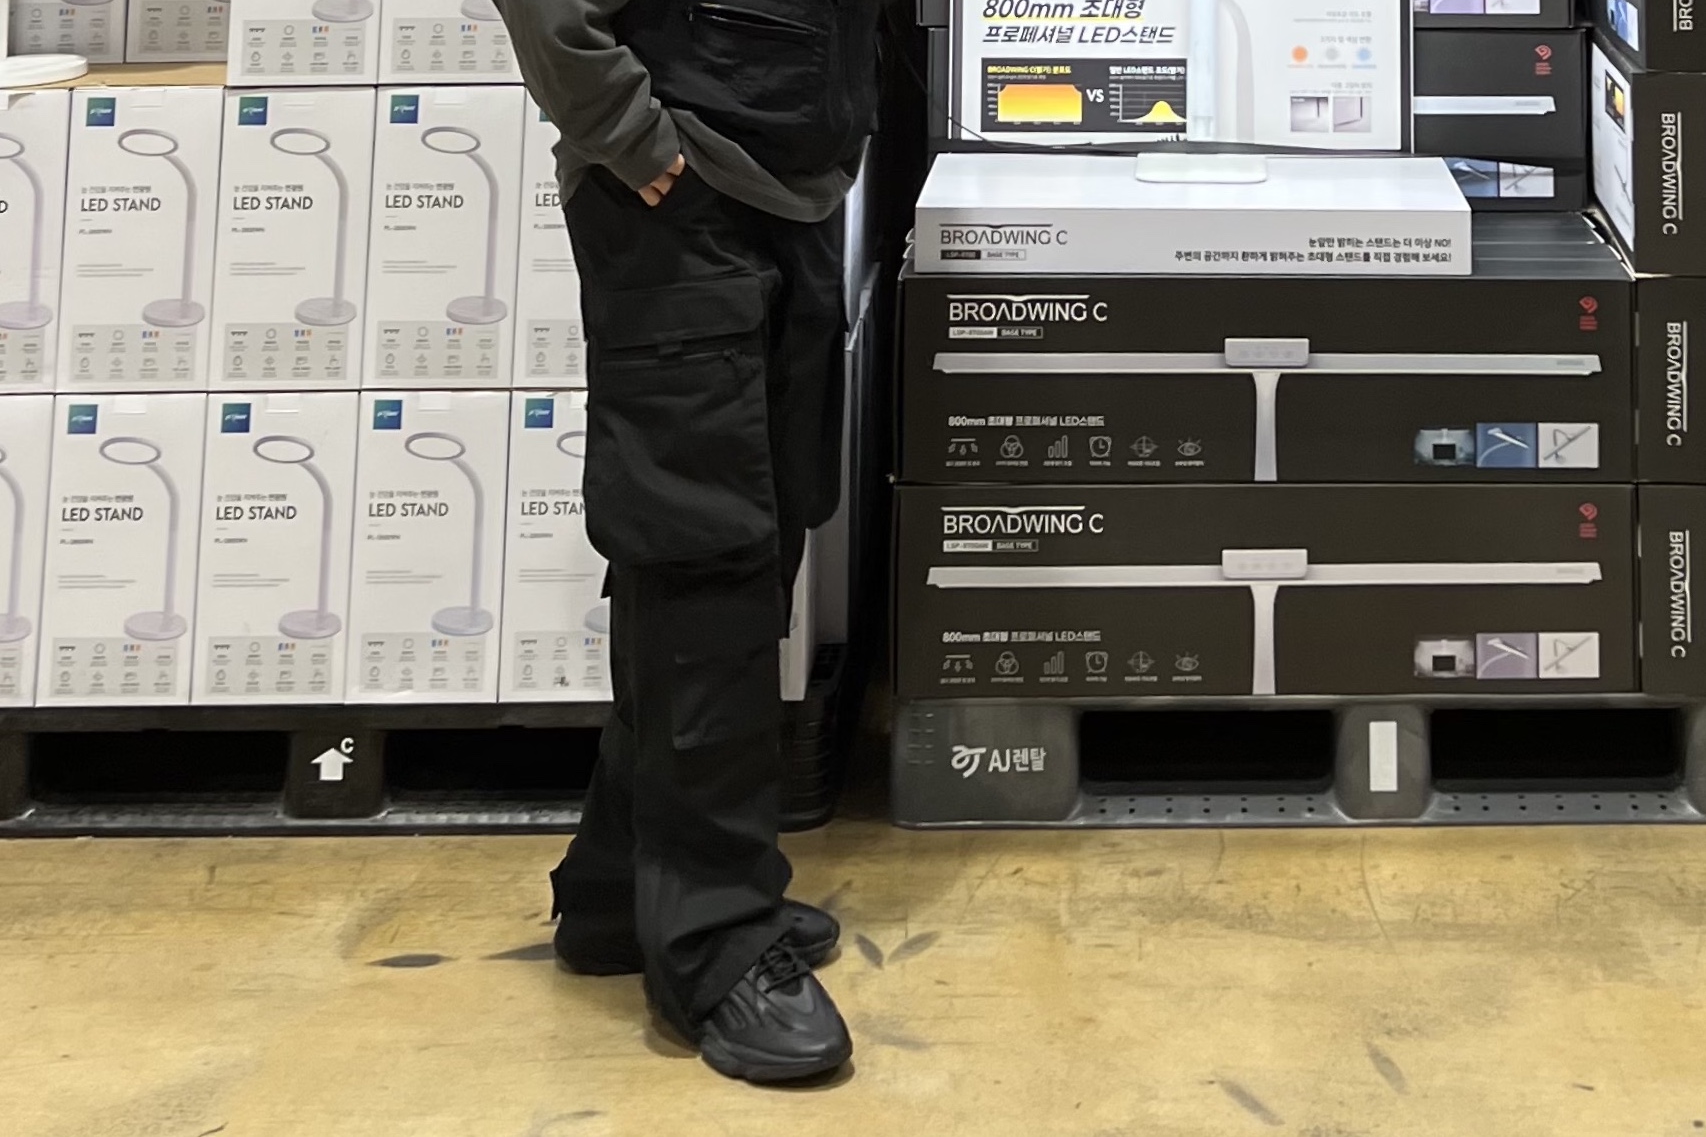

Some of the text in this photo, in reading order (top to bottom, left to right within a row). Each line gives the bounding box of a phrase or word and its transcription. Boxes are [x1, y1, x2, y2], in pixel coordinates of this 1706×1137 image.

[982, 25, 1176, 44] 프로페셔널 LED스탠드
[1086, 89, 1105, 102] VS
[1661, 112, 1678, 235] BROADWING C
[81, 198, 161, 212] LED STAND
[233, 196, 313, 211] LED STAND
[385, 195, 464, 209] LED STAND
[940, 230, 1068, 245] BROADWING C
[1403, 237, 1412, 248] 더
[1414, 237, 1432, 248] 이상
[1434, 238, 1452, 248] NO!
[1307, 251, 1333, 262] 초대형
[1422, 251, 1452, 262] 보세요!
[950, 302, 1108, 322] BROADWING C
[1667, 322, 1682, 446] BROADWING C
[948, 416, 986, 427] 800mm
[62, 507, 144, 522] LED STAND
[216, 506, 297, 520] LED STAND
[369, 502, 449, 517] LED STAND
[521, 501, 586, 516] LED STAN
[943, 513, 1104, 534] BROADWING C
[1670, 531, 1685, 658] BROADWING C
[942, 631, 981, 643] 800mm
[340, 737, 354, 753] C
[988, 746, 1048, 772] AJ렌탈
